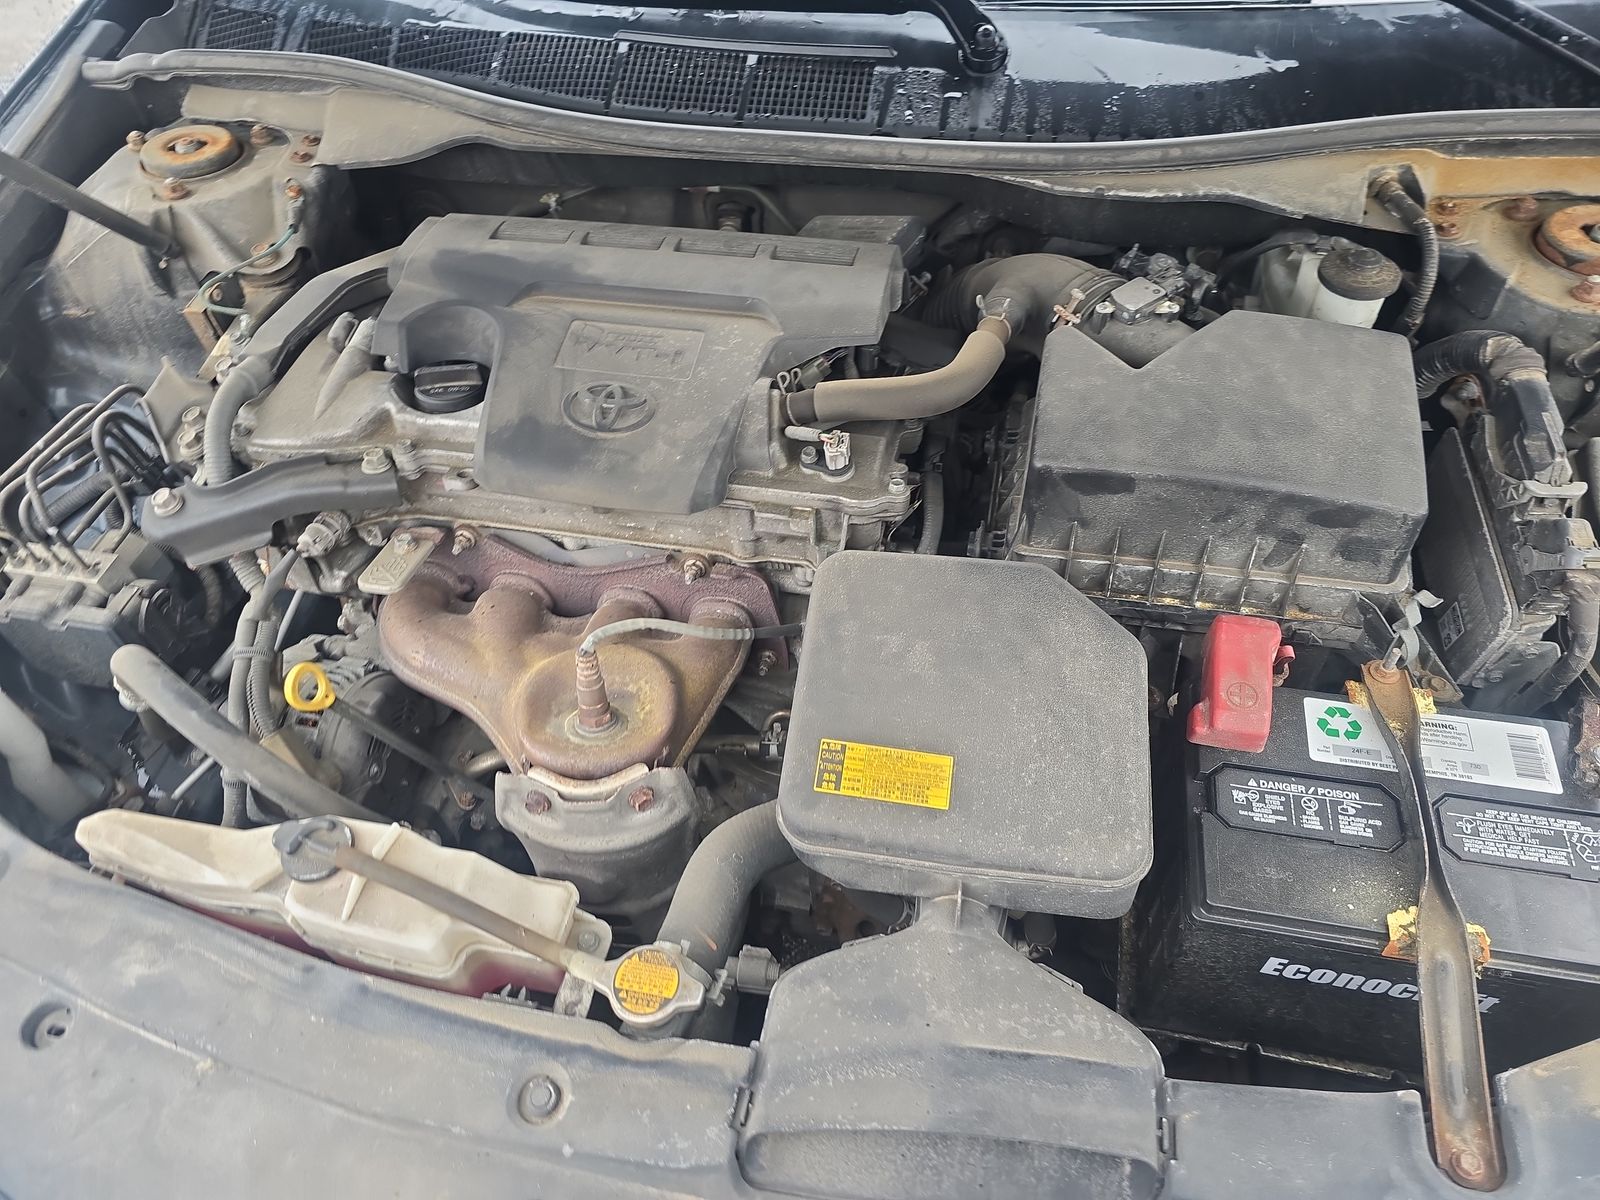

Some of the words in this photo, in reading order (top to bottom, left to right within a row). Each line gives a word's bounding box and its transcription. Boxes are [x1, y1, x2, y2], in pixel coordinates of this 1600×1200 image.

[1420, 721, 1458, 731] ARNING:
[1421, 737, 1468, 748] Warnings.ca.gov
[821, 750, 844, 760] CAUTION
[819, 762, 843, 771] ATTENTION
[1339, 757, 1371, 766] DISTRIBUTED
[1260, 780, 1306, 794] DANGER
[1317, 788, 1360, 800] POISON
[1264, 794, 1286, 802] SHIELD
[1252, 802, 1284, 811] EXPLOSIVE
[1476, 820, 1497, 828] FLUSH
[1514, 824, 1555, 836] IMMEDIATELY
[1479, 832, 1506, 840] MEDICAL
[1506, 834, 1523, 842] HELP
[1524, 837, 1540, 845] FAST
[1260, 957, 1500, 1013] Econoct
